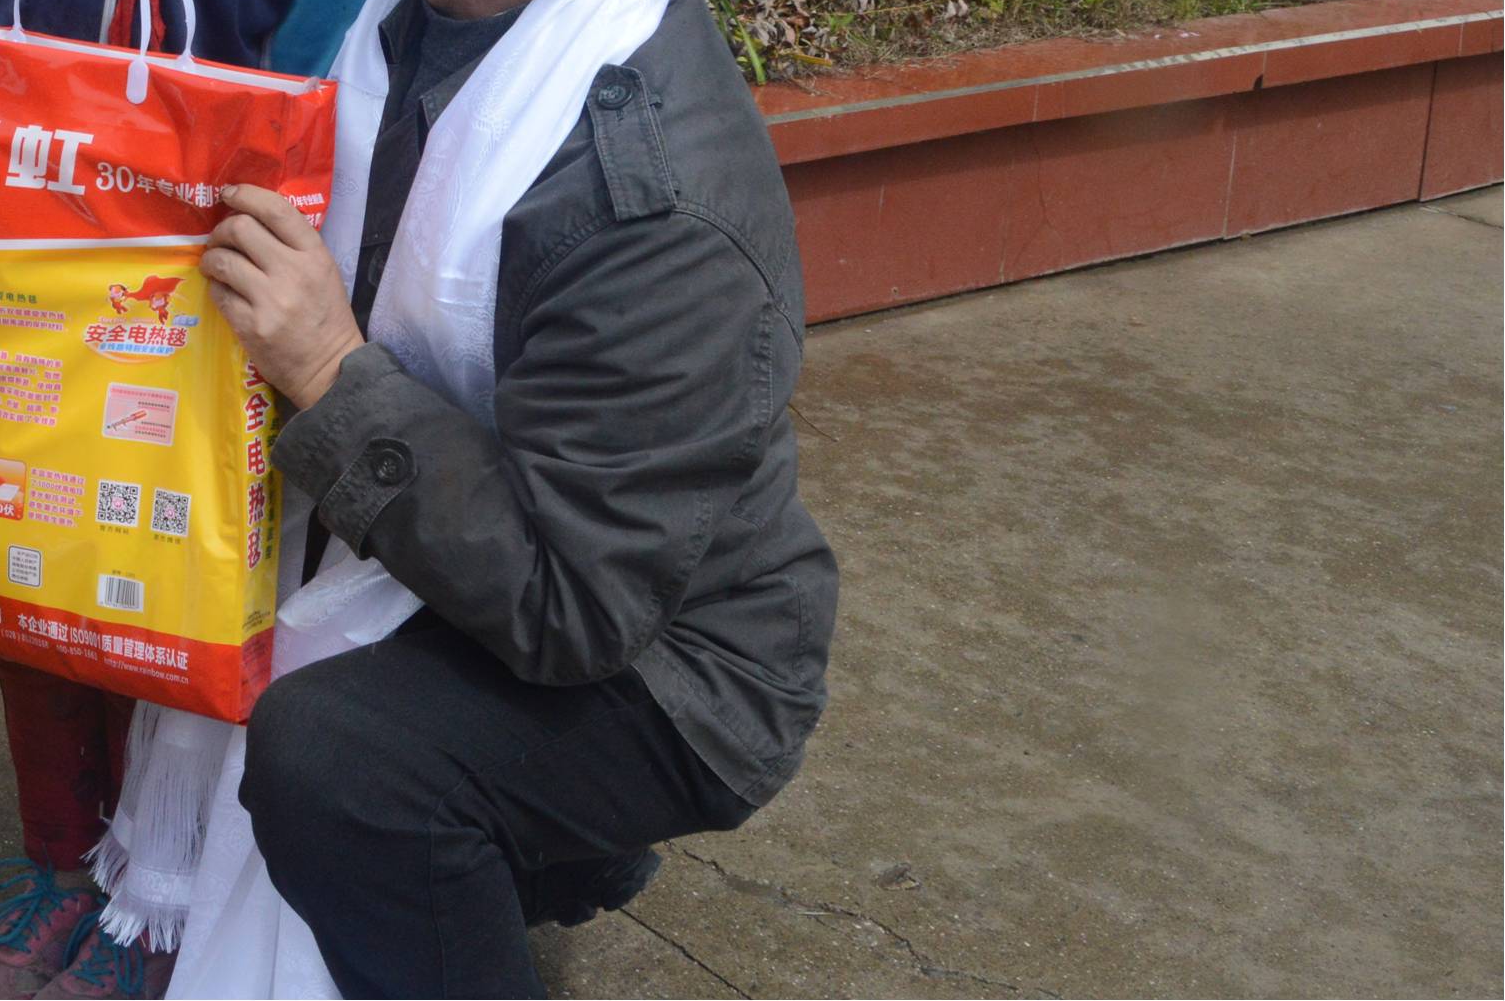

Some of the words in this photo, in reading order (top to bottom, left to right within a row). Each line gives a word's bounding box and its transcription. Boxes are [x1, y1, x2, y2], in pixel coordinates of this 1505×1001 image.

[85, 324, 188, 347] 安全电热毯
